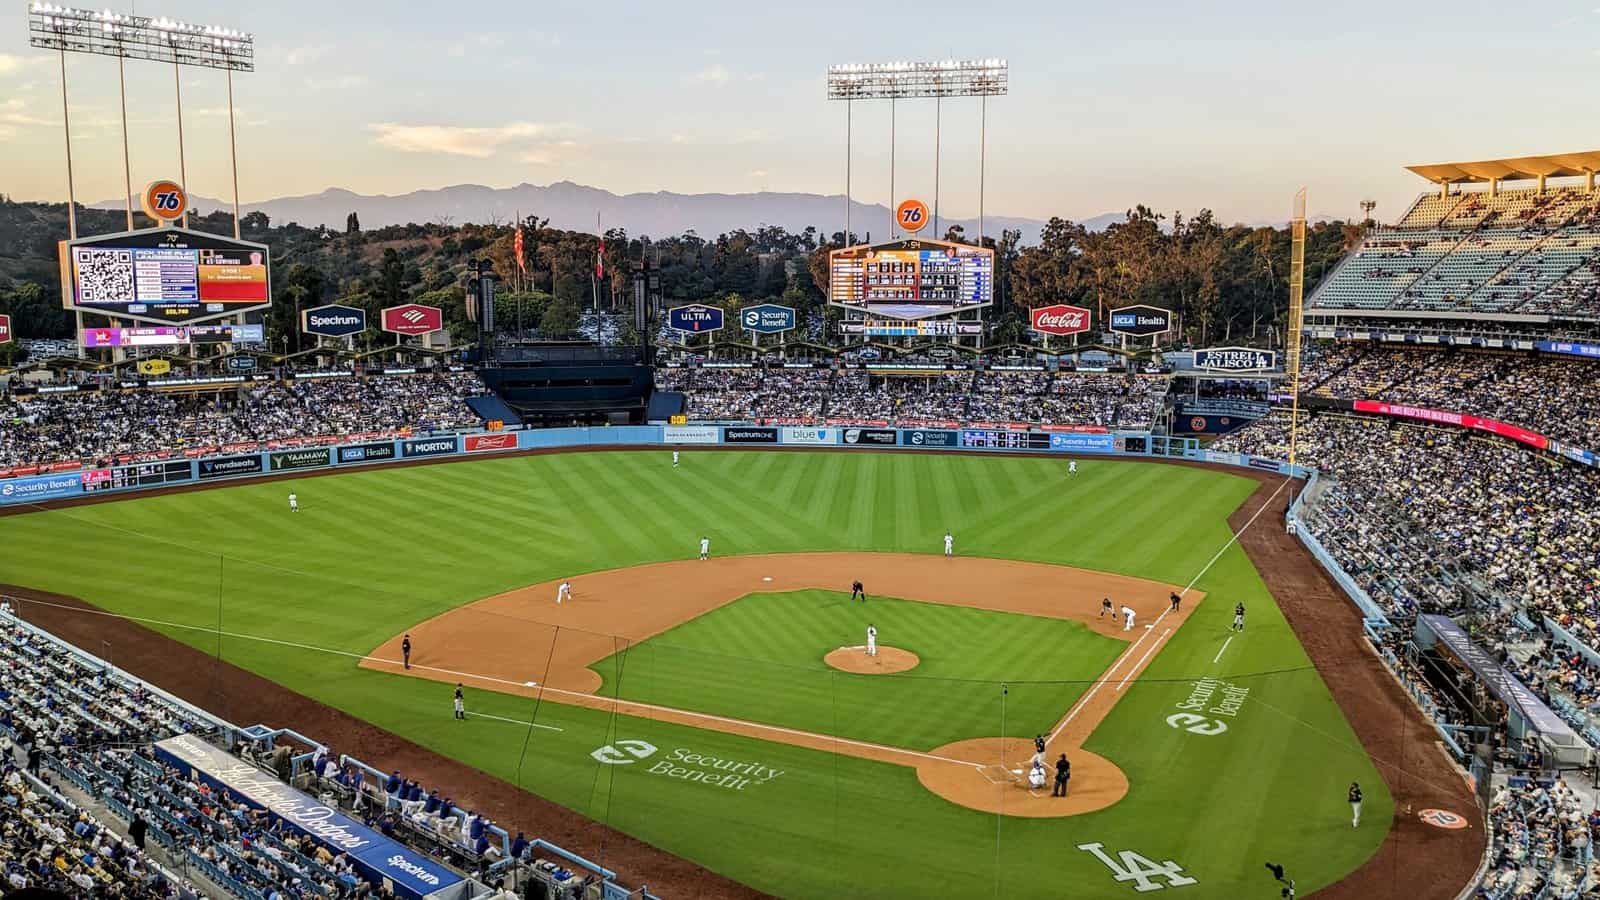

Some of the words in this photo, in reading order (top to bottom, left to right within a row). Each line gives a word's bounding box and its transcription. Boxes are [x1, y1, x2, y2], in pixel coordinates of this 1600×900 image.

[156, 192, 180, 210] 76
[902, 207, 922, 222] 76
[310, 315, 358, 327] Spectrum
[681, 313, 712, 321] ULTRA
[761, 311, 790, 320] Security
[1137, 316, 1165, 325] Health
[761, 319, 786, 327] Benefit
[1201, 359, 1253, 368] JALISCO
[792, 430, 815, 439] blue
[415, 441, 453, 453] MORTON
[1062, 438, 1086, 446] Security
[1087, 438, 1109, 446] Benefit
[345, 450, 362, 458] UCLA
[366, 447, 391, 457] Health
[15, 483, 48, 493] Security
[49, 479, 76, 488] Benefit
[1175, 676, 1225, 711] Security
[1209, 683, 1249, 716] Benefit
[665, 747, 785, 782] Security
[647, 760, 750, 790] Benefit
[1430, 812, 1457, 825] 76
[294, 805, 370, 850] Dodgers
[387, 854, 440, 886] Spectrum
[1076, 841, 1198, 892] LA
